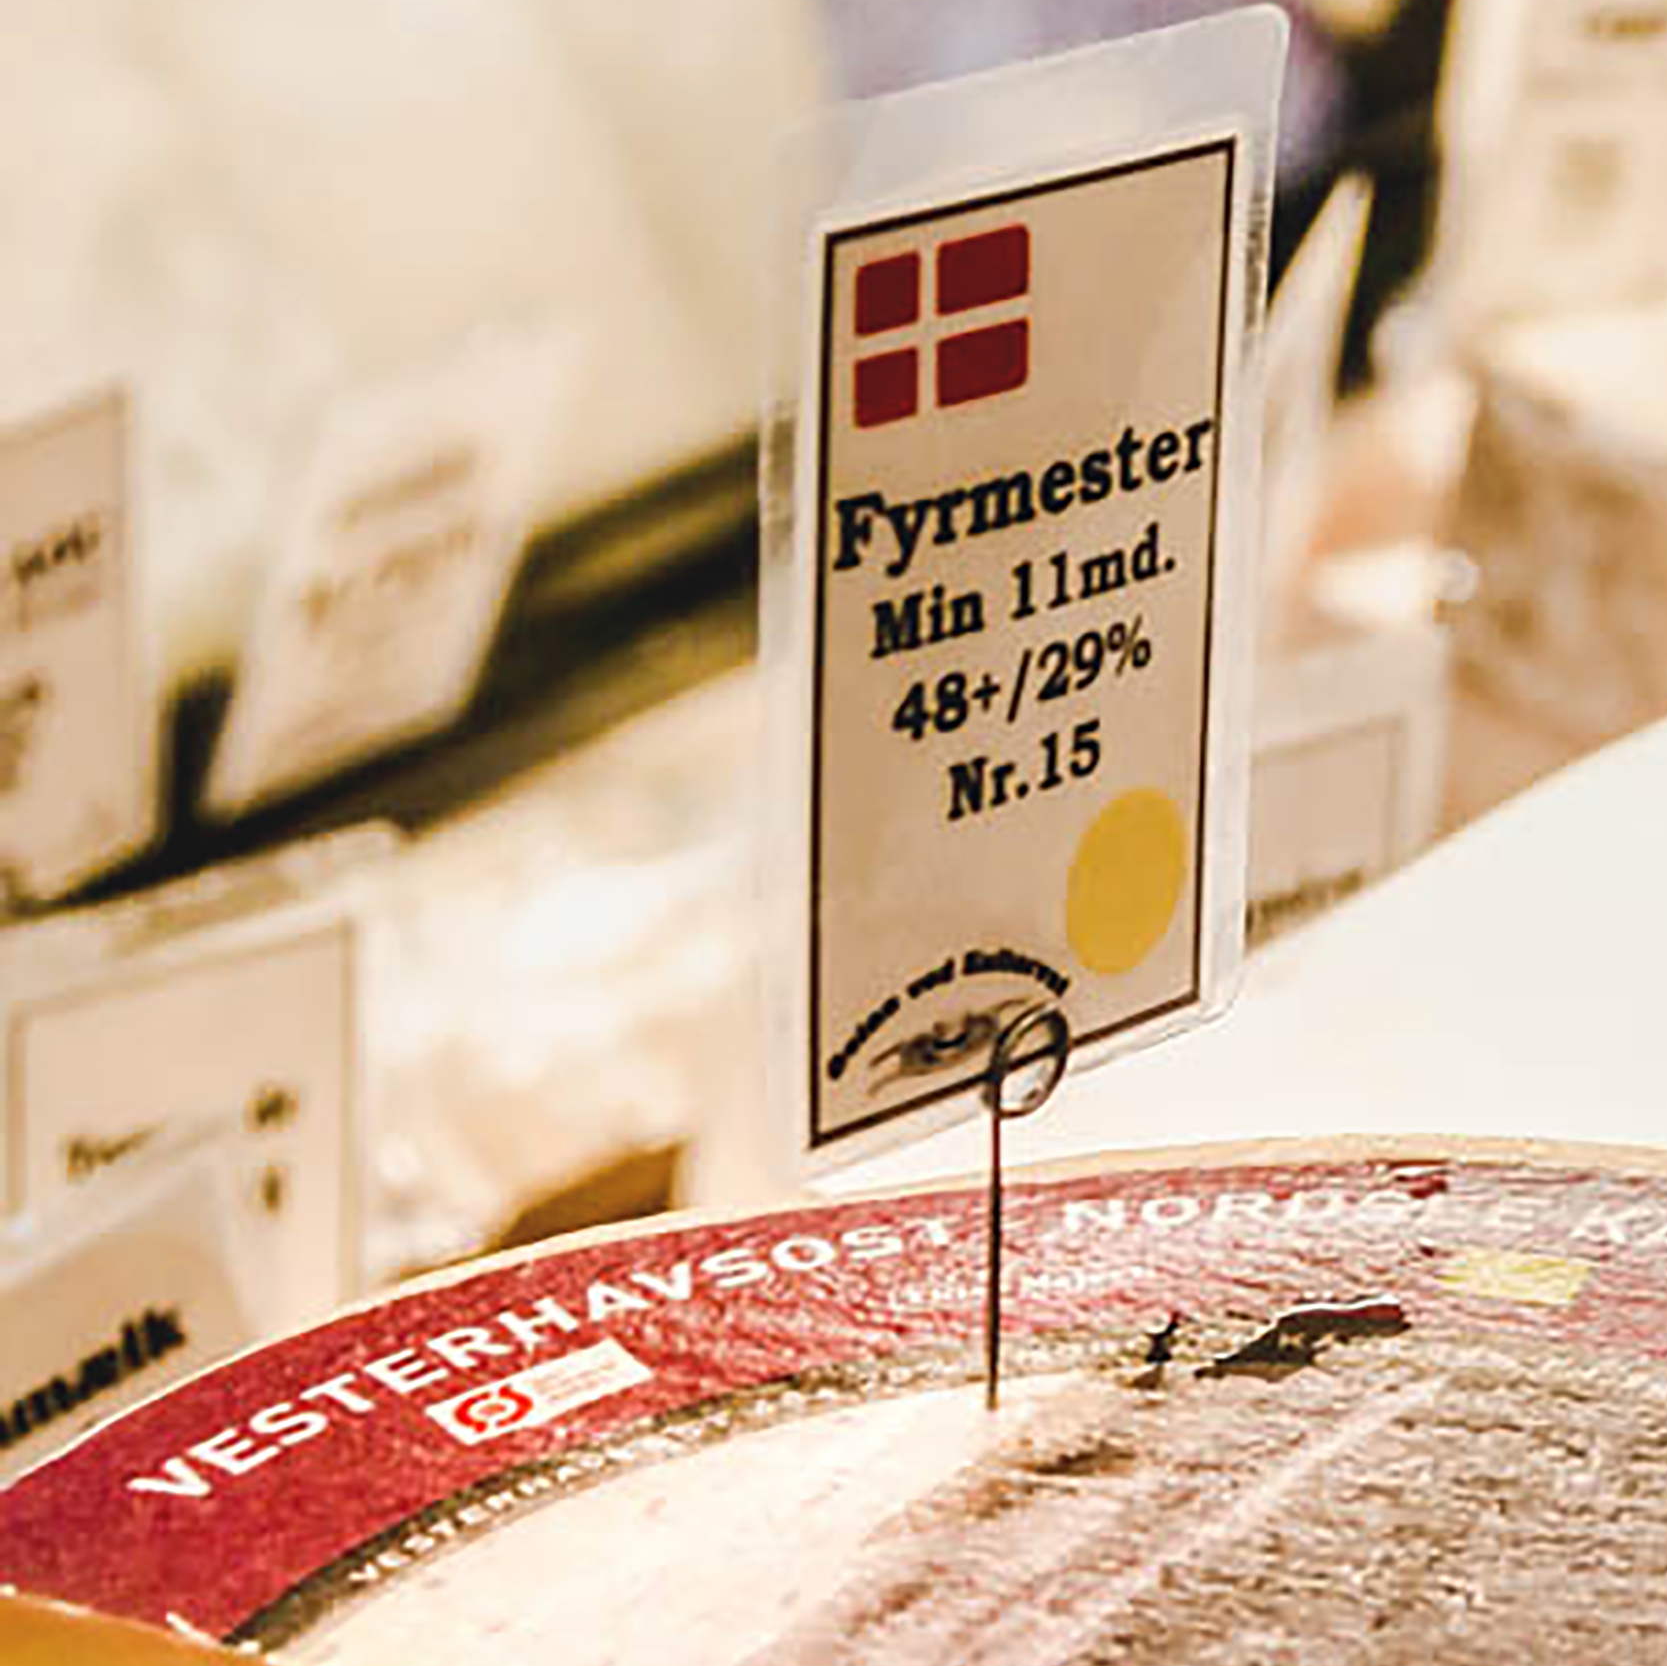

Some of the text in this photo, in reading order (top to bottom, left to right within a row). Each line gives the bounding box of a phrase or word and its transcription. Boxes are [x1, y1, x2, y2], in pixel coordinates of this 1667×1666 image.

[832, 418, 1212, 578] Fyrmester
[869, 520, 1176, 659] Min 11md.
[892, 614, 1152, 742] 48+/29%
[947, 717, 1101, 822] Nr.15
[126, 1215, 964, 1503] VESTERHAVSOST
